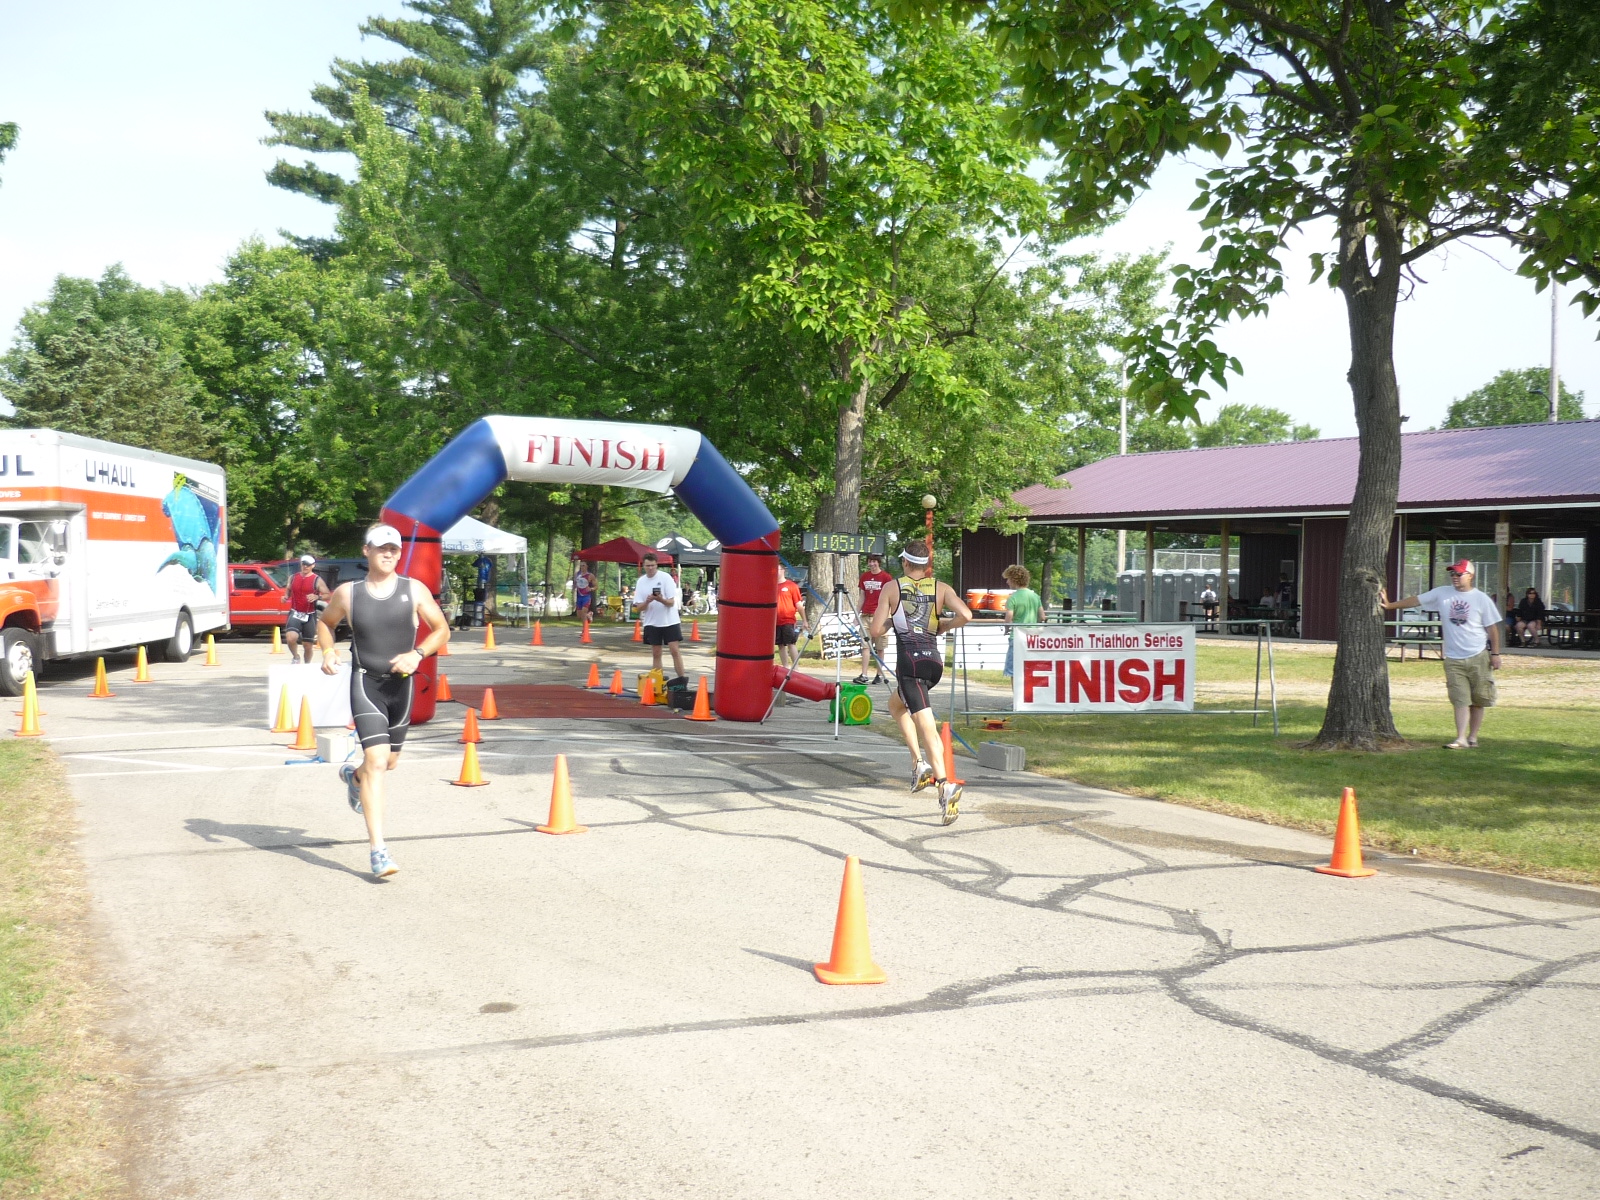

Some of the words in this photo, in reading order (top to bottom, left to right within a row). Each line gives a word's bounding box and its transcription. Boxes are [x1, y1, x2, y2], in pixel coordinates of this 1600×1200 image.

[523, 434, 667, 471] FINISH
[85, 459, 136, 488] U-HAUL
[813, 533, 876, 553] 1:05:17
[1026, 633, 1084, 649] Wisconsin
[1088, 632, 1139, 649] Triathlon
[1144, 632, 1183, 648] Series
[1023, 658, 1185, 704] FINISH
